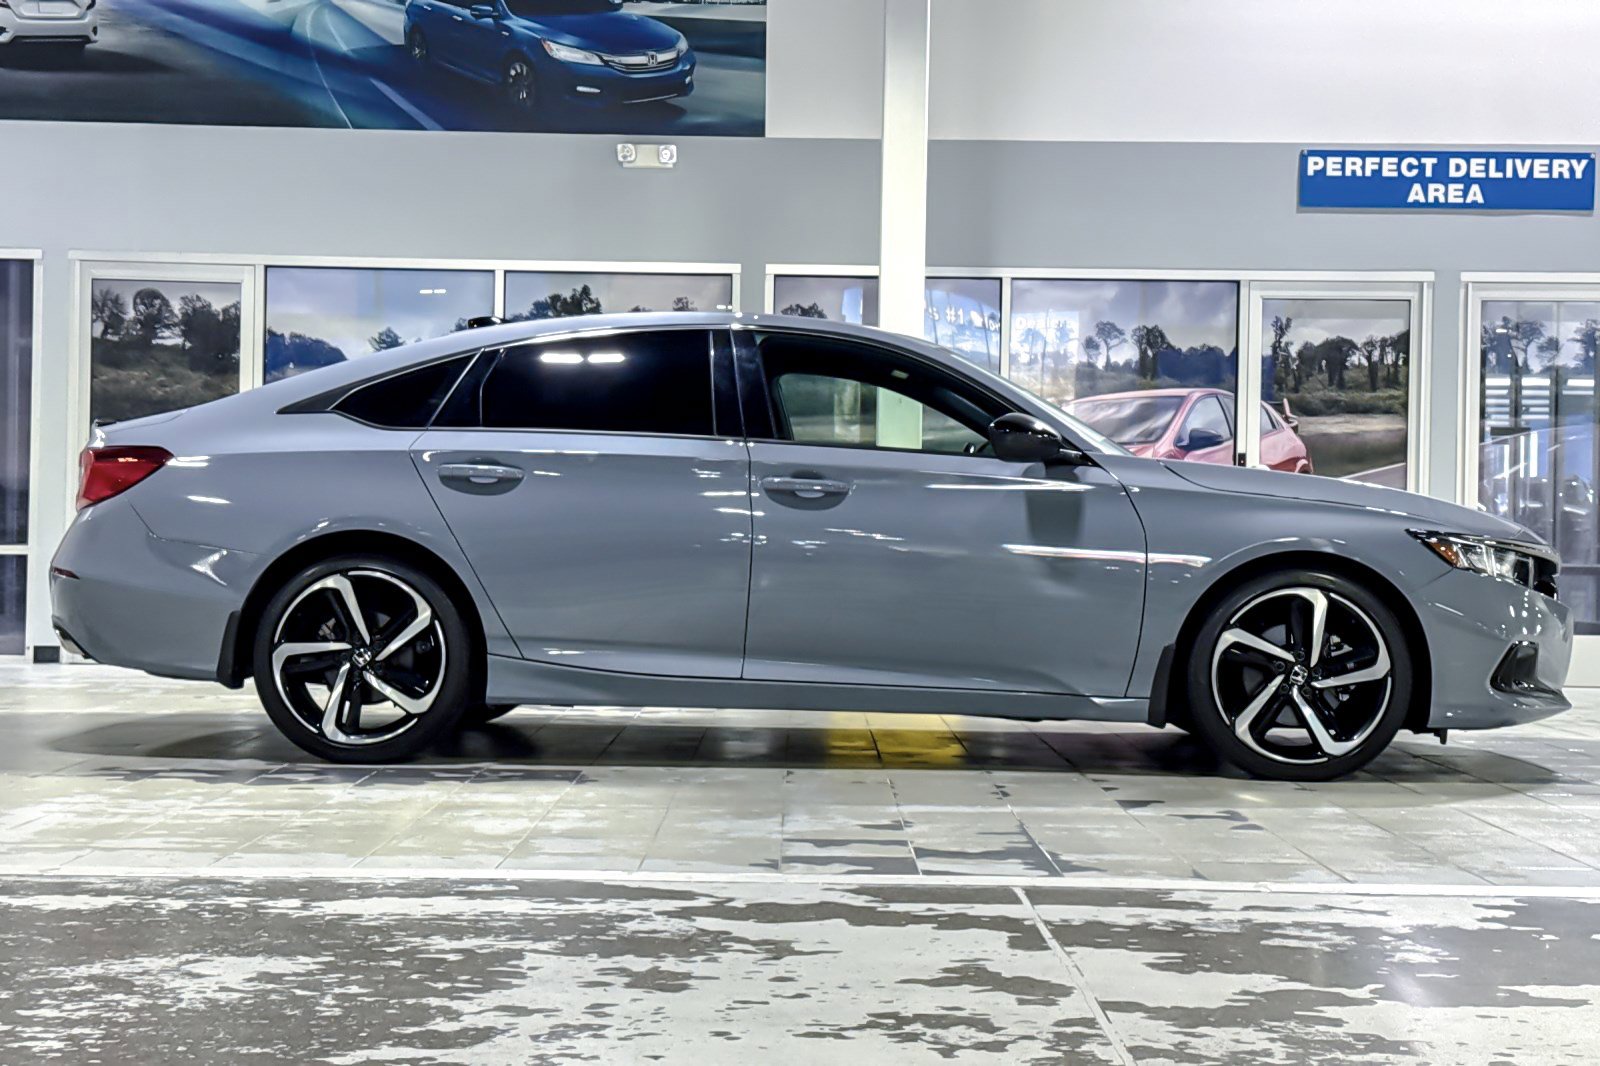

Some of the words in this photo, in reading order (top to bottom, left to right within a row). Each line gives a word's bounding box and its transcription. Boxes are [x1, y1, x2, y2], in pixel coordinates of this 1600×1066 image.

[1307, 156, 1438, 178] PERFECT
[1448, 158, 1589, 179] DELIVERY
[1407, 183, 1485, 204] AREA
